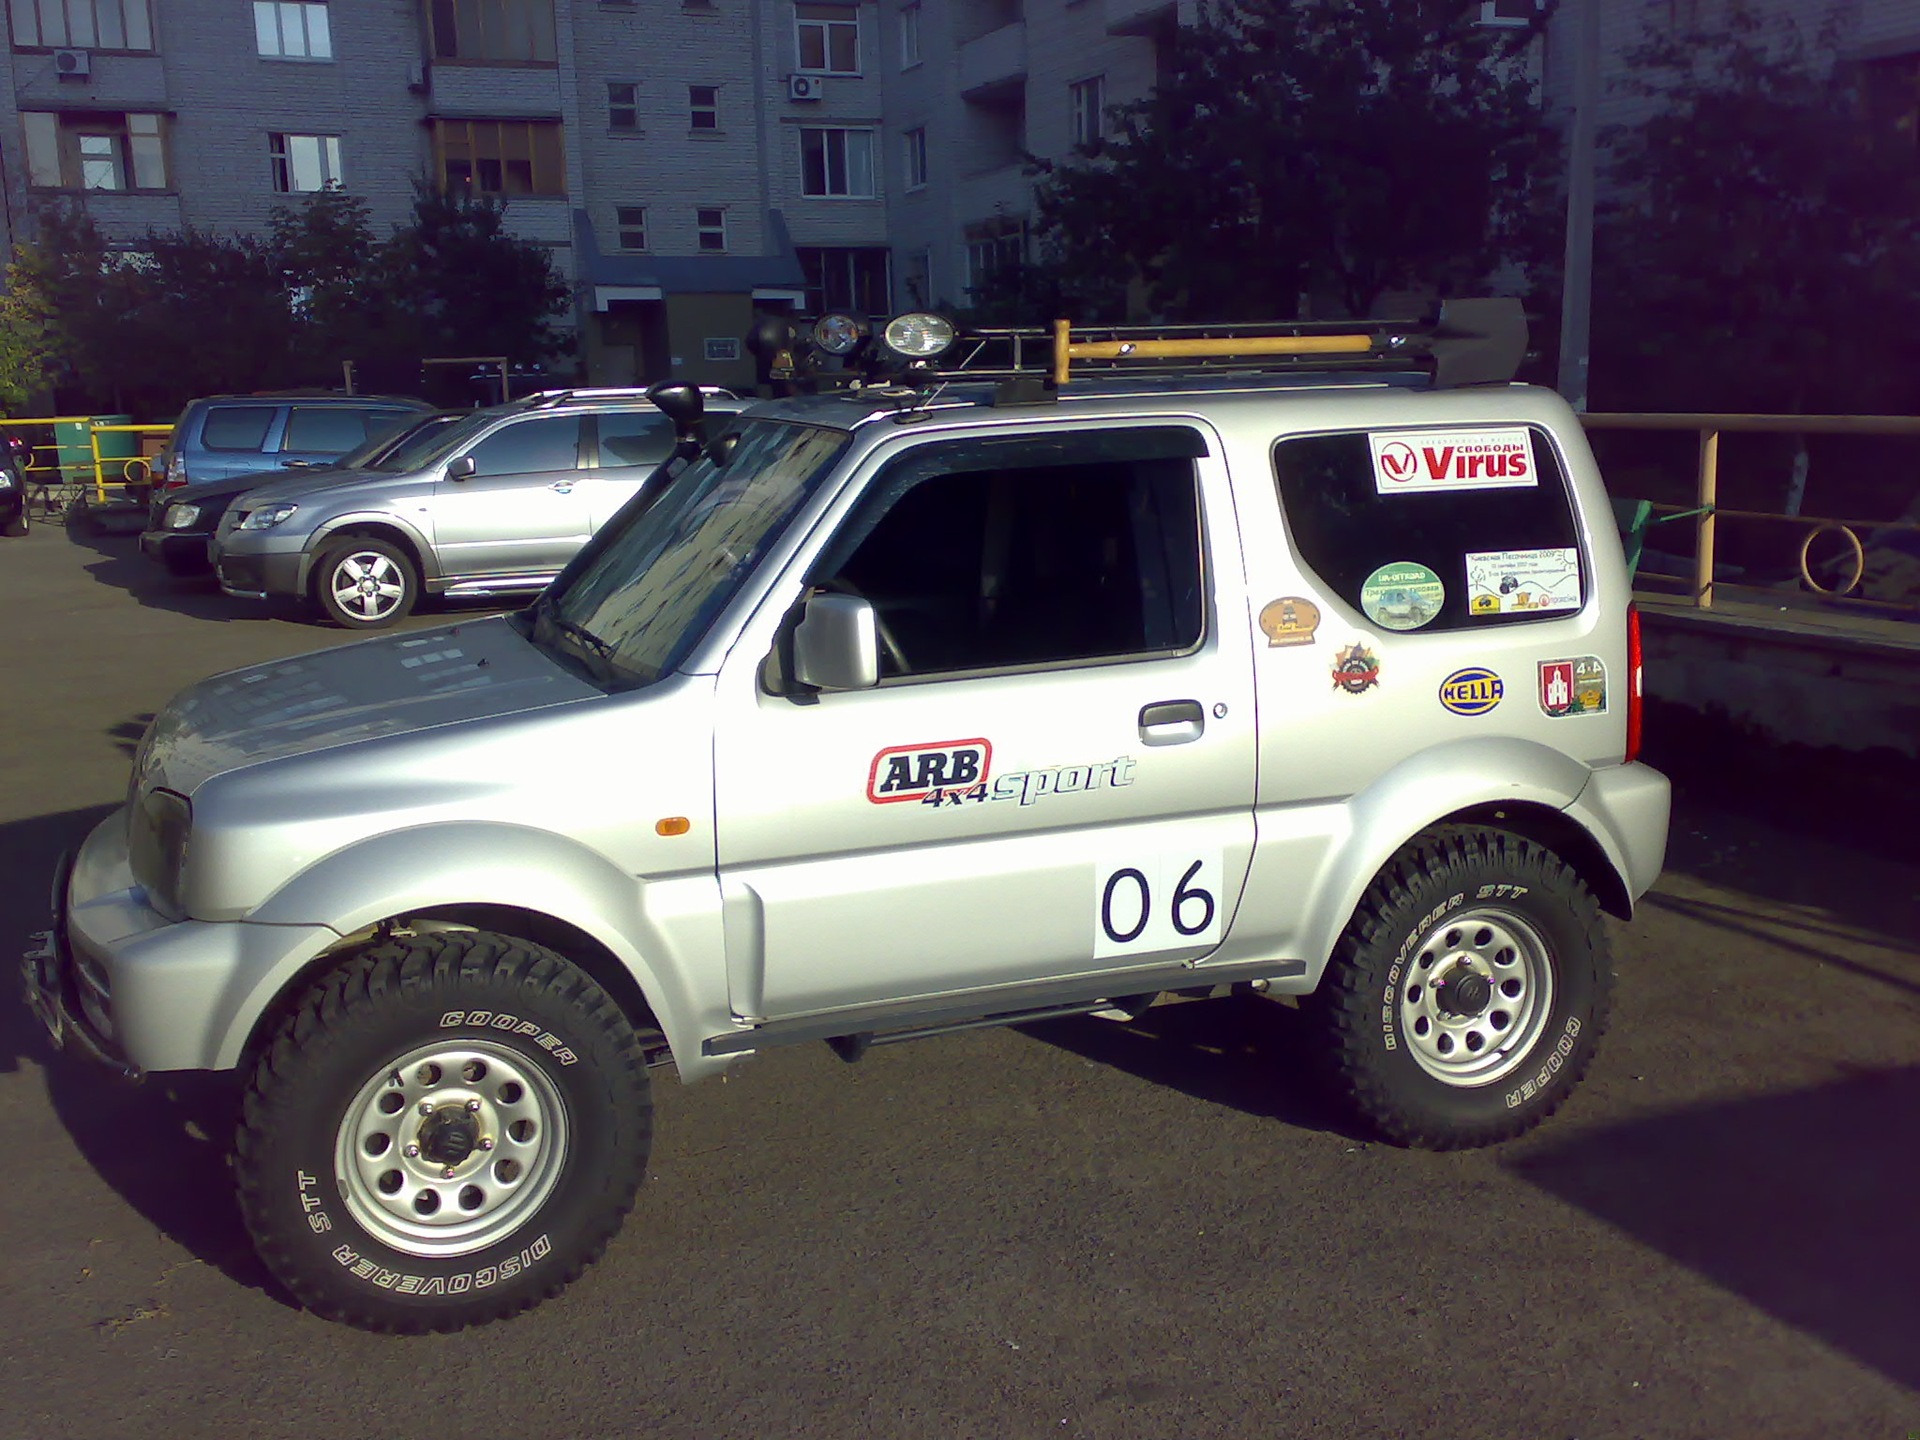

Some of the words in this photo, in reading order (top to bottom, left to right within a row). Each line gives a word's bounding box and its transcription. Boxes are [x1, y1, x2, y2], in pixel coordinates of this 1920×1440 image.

[1422, 446, 1527, 481] Virus
[1456, 444, 1525, 454] СВОБОДЫ
[1444, 680, 1502, 701] HELLA
[880, 749, 980, 793] ARB
[921, 783, 988, 808] 4x4
[991, 755, 1137, 806] sport
[1101, 859, 1215, 943] 06
[1382, 893, 1464, 1051] DISCOVERER
[1476, 884, 1529, 900] STT
[440, 1010, 578, 1066] COOPER
[1505, 1016, 1582, 1109] COOPER
[297, 1169, 333, 1235] STT
[332, 1234, 552, 1296] DISCOVERER
